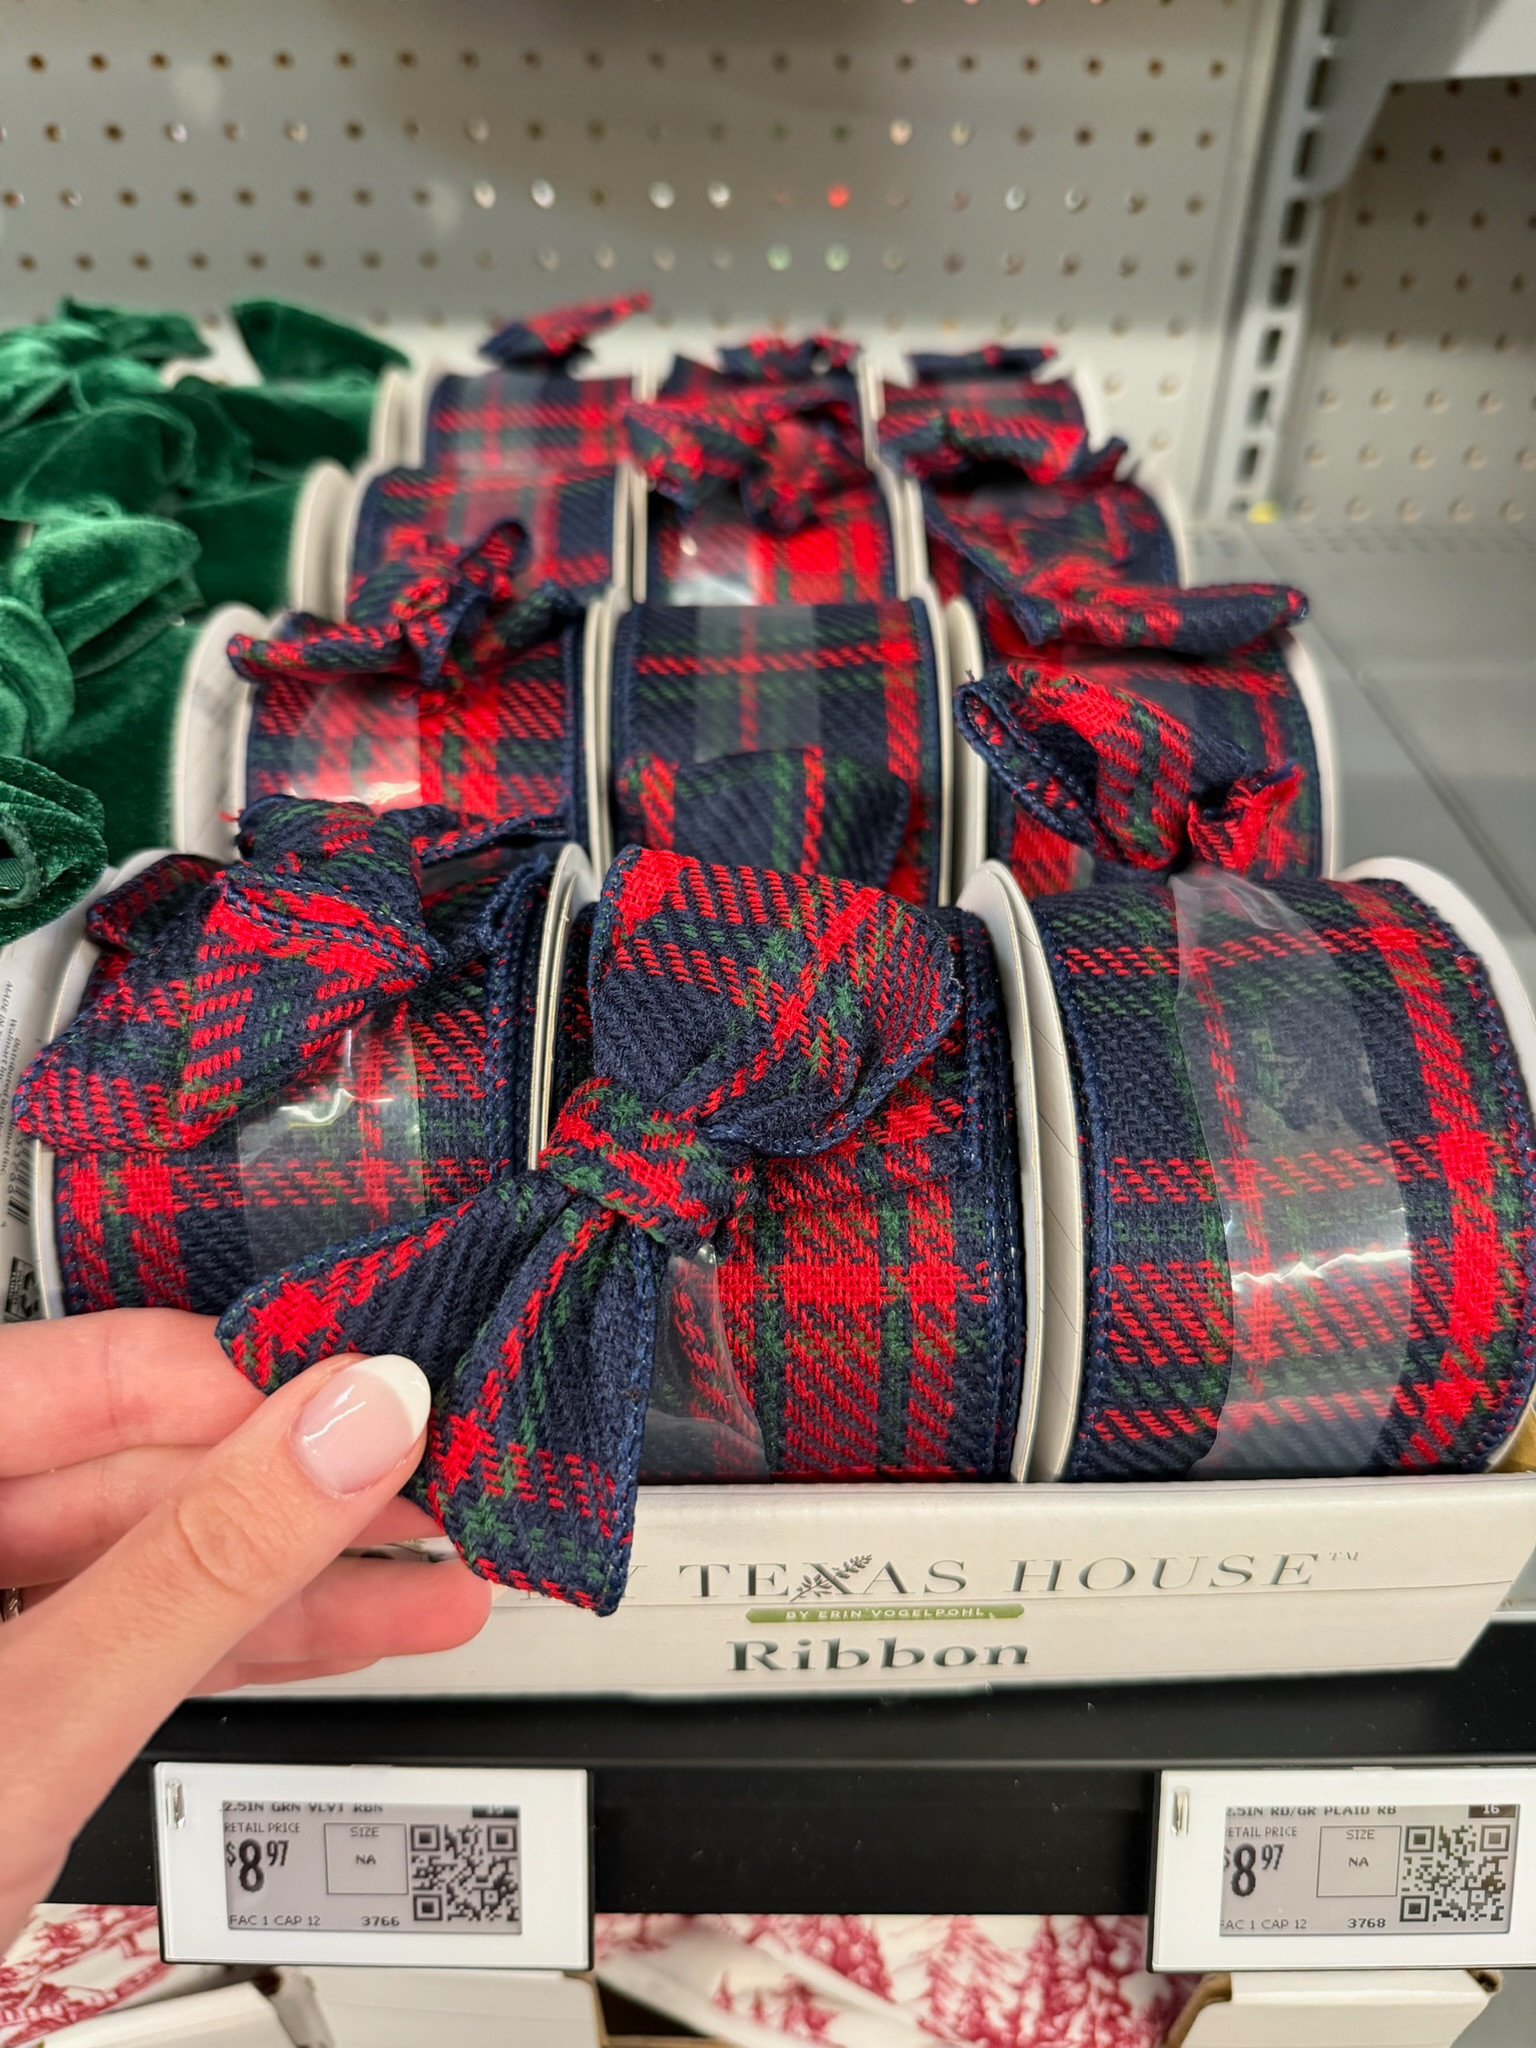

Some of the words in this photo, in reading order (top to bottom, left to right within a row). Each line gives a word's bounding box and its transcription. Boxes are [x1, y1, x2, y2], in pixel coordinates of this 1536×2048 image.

[679, 1558, 967, 1598] TEXAS
[1003, 1553, 1319, 1594] HOUSE
[785, 1609, 810, 1622] BY
[817, 1609, 865, 1621] ERIN
[870, 1607, 985, 1620] VOGELPOHL
[726, 1636, 1030, 1671] Ribbon
[1323, 1805, 1370, 1815] PLAID
[1482, 1804, 1500, 1815] 16
[223, 1822, 265, 1833] RETAIL
[268, 1822, 301, 1834] PRICE
[350, 1826, 380, 1838] SIZE
[1226, 1826, 1262, 1838] ETAIL
[1265, 1825, 1298, 1838] PRICE
[1346, 1828, 1376, 1840] SIZE
[355, 1854, 377, 1865] NA
[1348, 1856, 1370, 1868] NA
[229, 1914, 257, 1926] FAC
[274, 1915, 302, 1926] CAP
[308, 1915, 321, 1926] 12
[361, 1915, 400, 1927] 3766
[1261, 1919, 1289, 1930] CAP
[1294, 1919, 1308, 1930] 12
[1347, 1918, 1386, 1929] 3768
